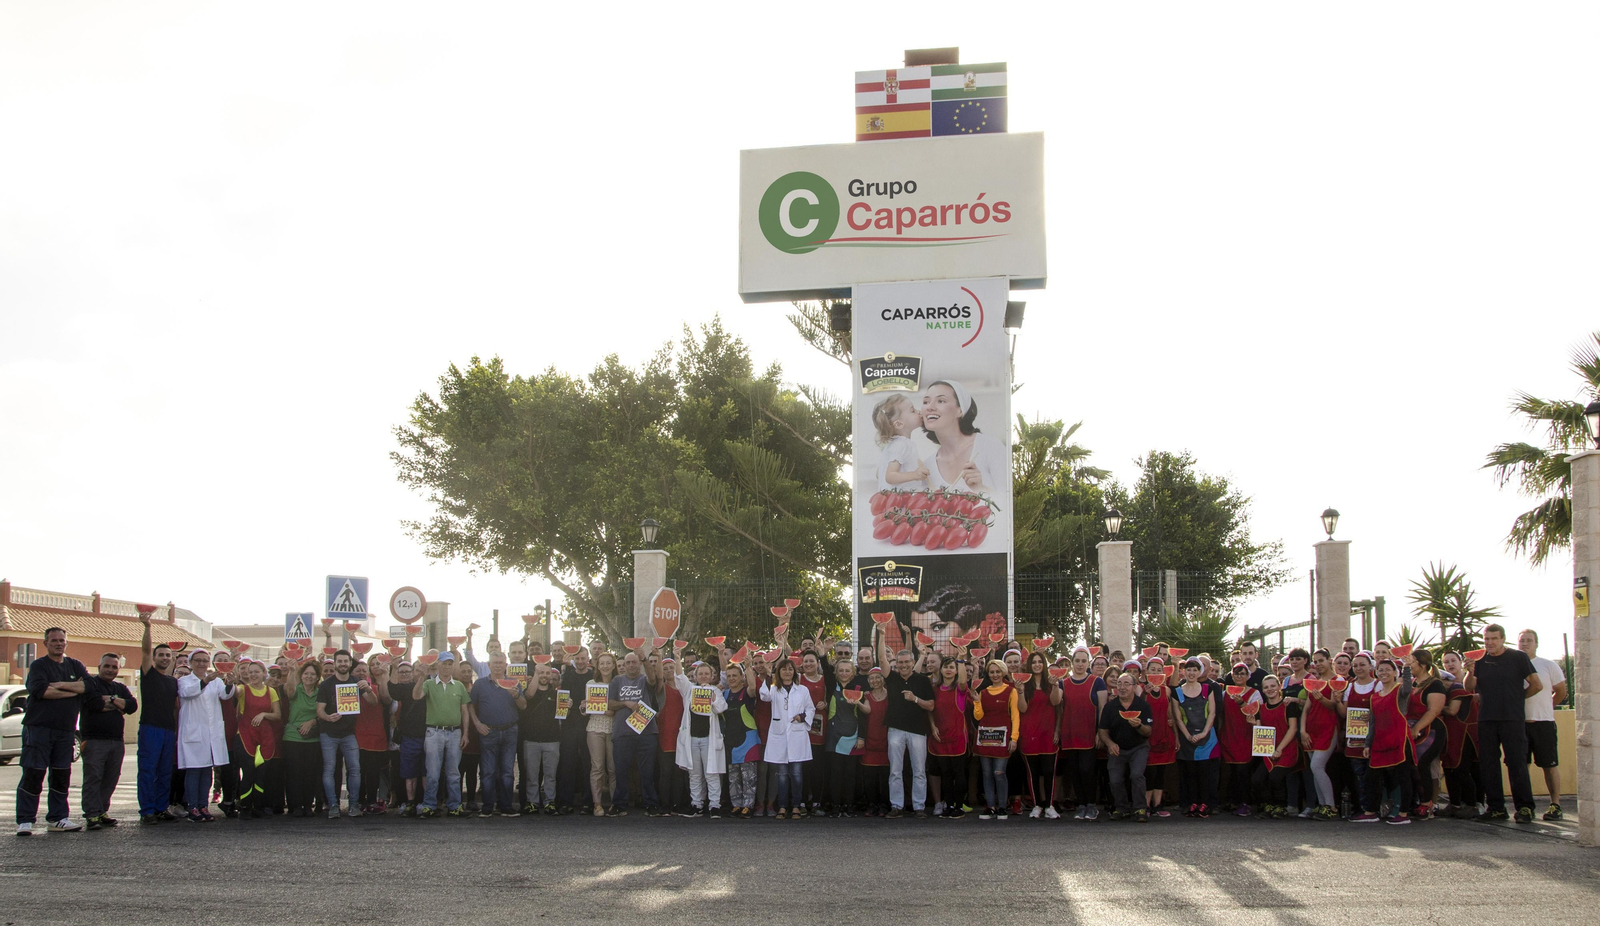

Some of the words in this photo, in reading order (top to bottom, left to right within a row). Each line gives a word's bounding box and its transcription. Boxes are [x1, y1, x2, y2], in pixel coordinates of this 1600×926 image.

[848, 178, 917, 199] Grupo
[779, 188, 820, 237] C
[847, 192, 1012, 235] Caparrós
[881, 303, 971, 321] CAPARRÓS
[926, 320, 972, 330] NATURE
[864, 365, 916, 378] Caparrós
[872, 378, 910, 387] LOBELLO
[654, 606, 678, 621] STOP
[340, 686, 357, 694] SABOR
[619, 685, 642, 697] Ford
[695, 688, 711, 696] SABOR
[338, 701, 359, 712] 2019
[587, 702, 608, 711] 2019
[691, 704, 711, 714] 2019
[628, 715, 646, 731] 2019
[1256, 728, 1274, 736] SABOR
[1347, 726, 1369, 736] 2019
[1253, 744, 1275, 754] 2019
